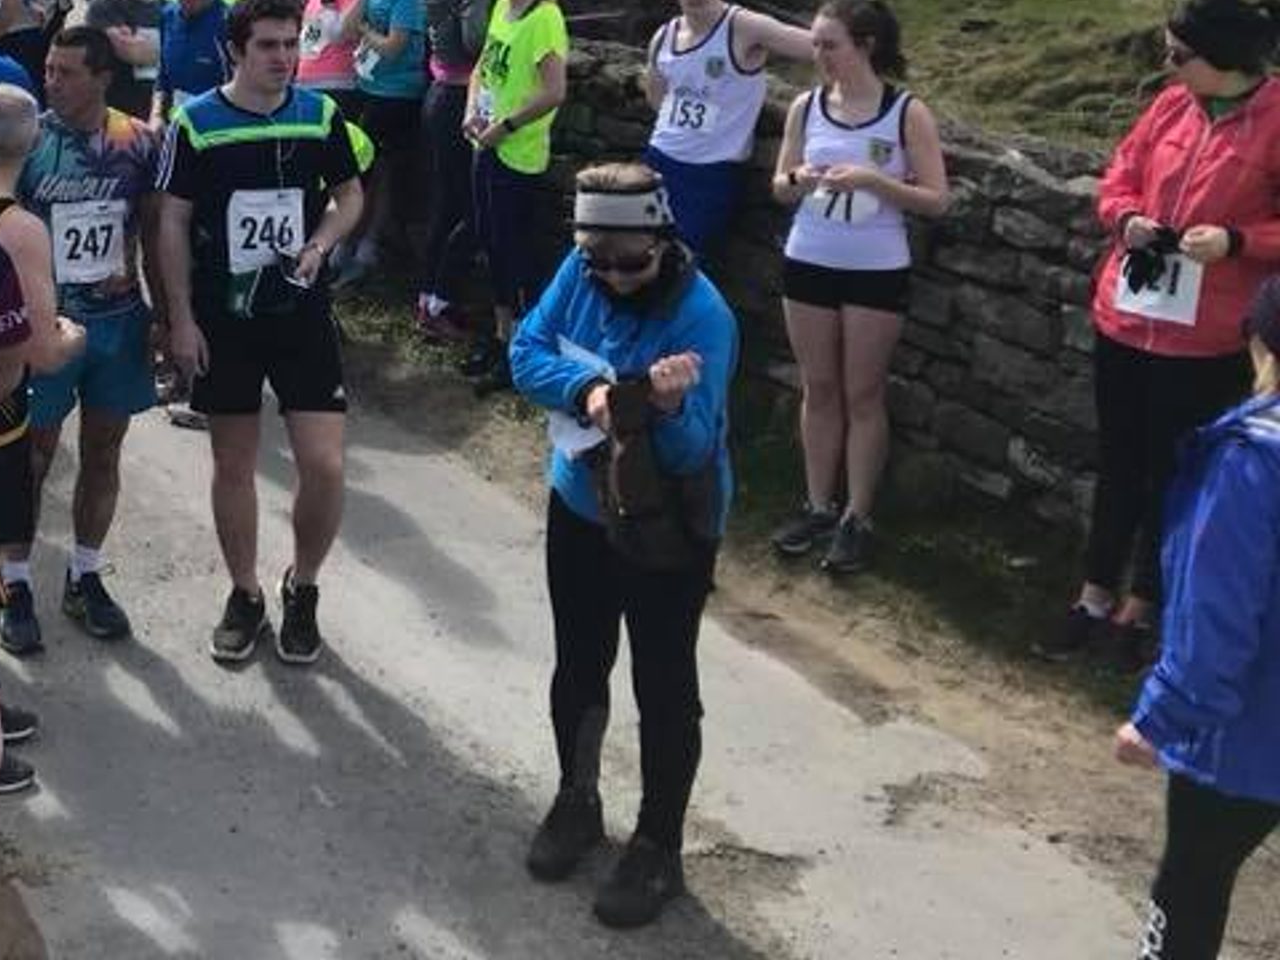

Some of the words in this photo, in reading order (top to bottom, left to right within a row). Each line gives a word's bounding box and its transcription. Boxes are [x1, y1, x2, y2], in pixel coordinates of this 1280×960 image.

[669, 97, 707, 130] 153
[64, 224, 114, 261] 247
[239, 215, 295, 251] 246
